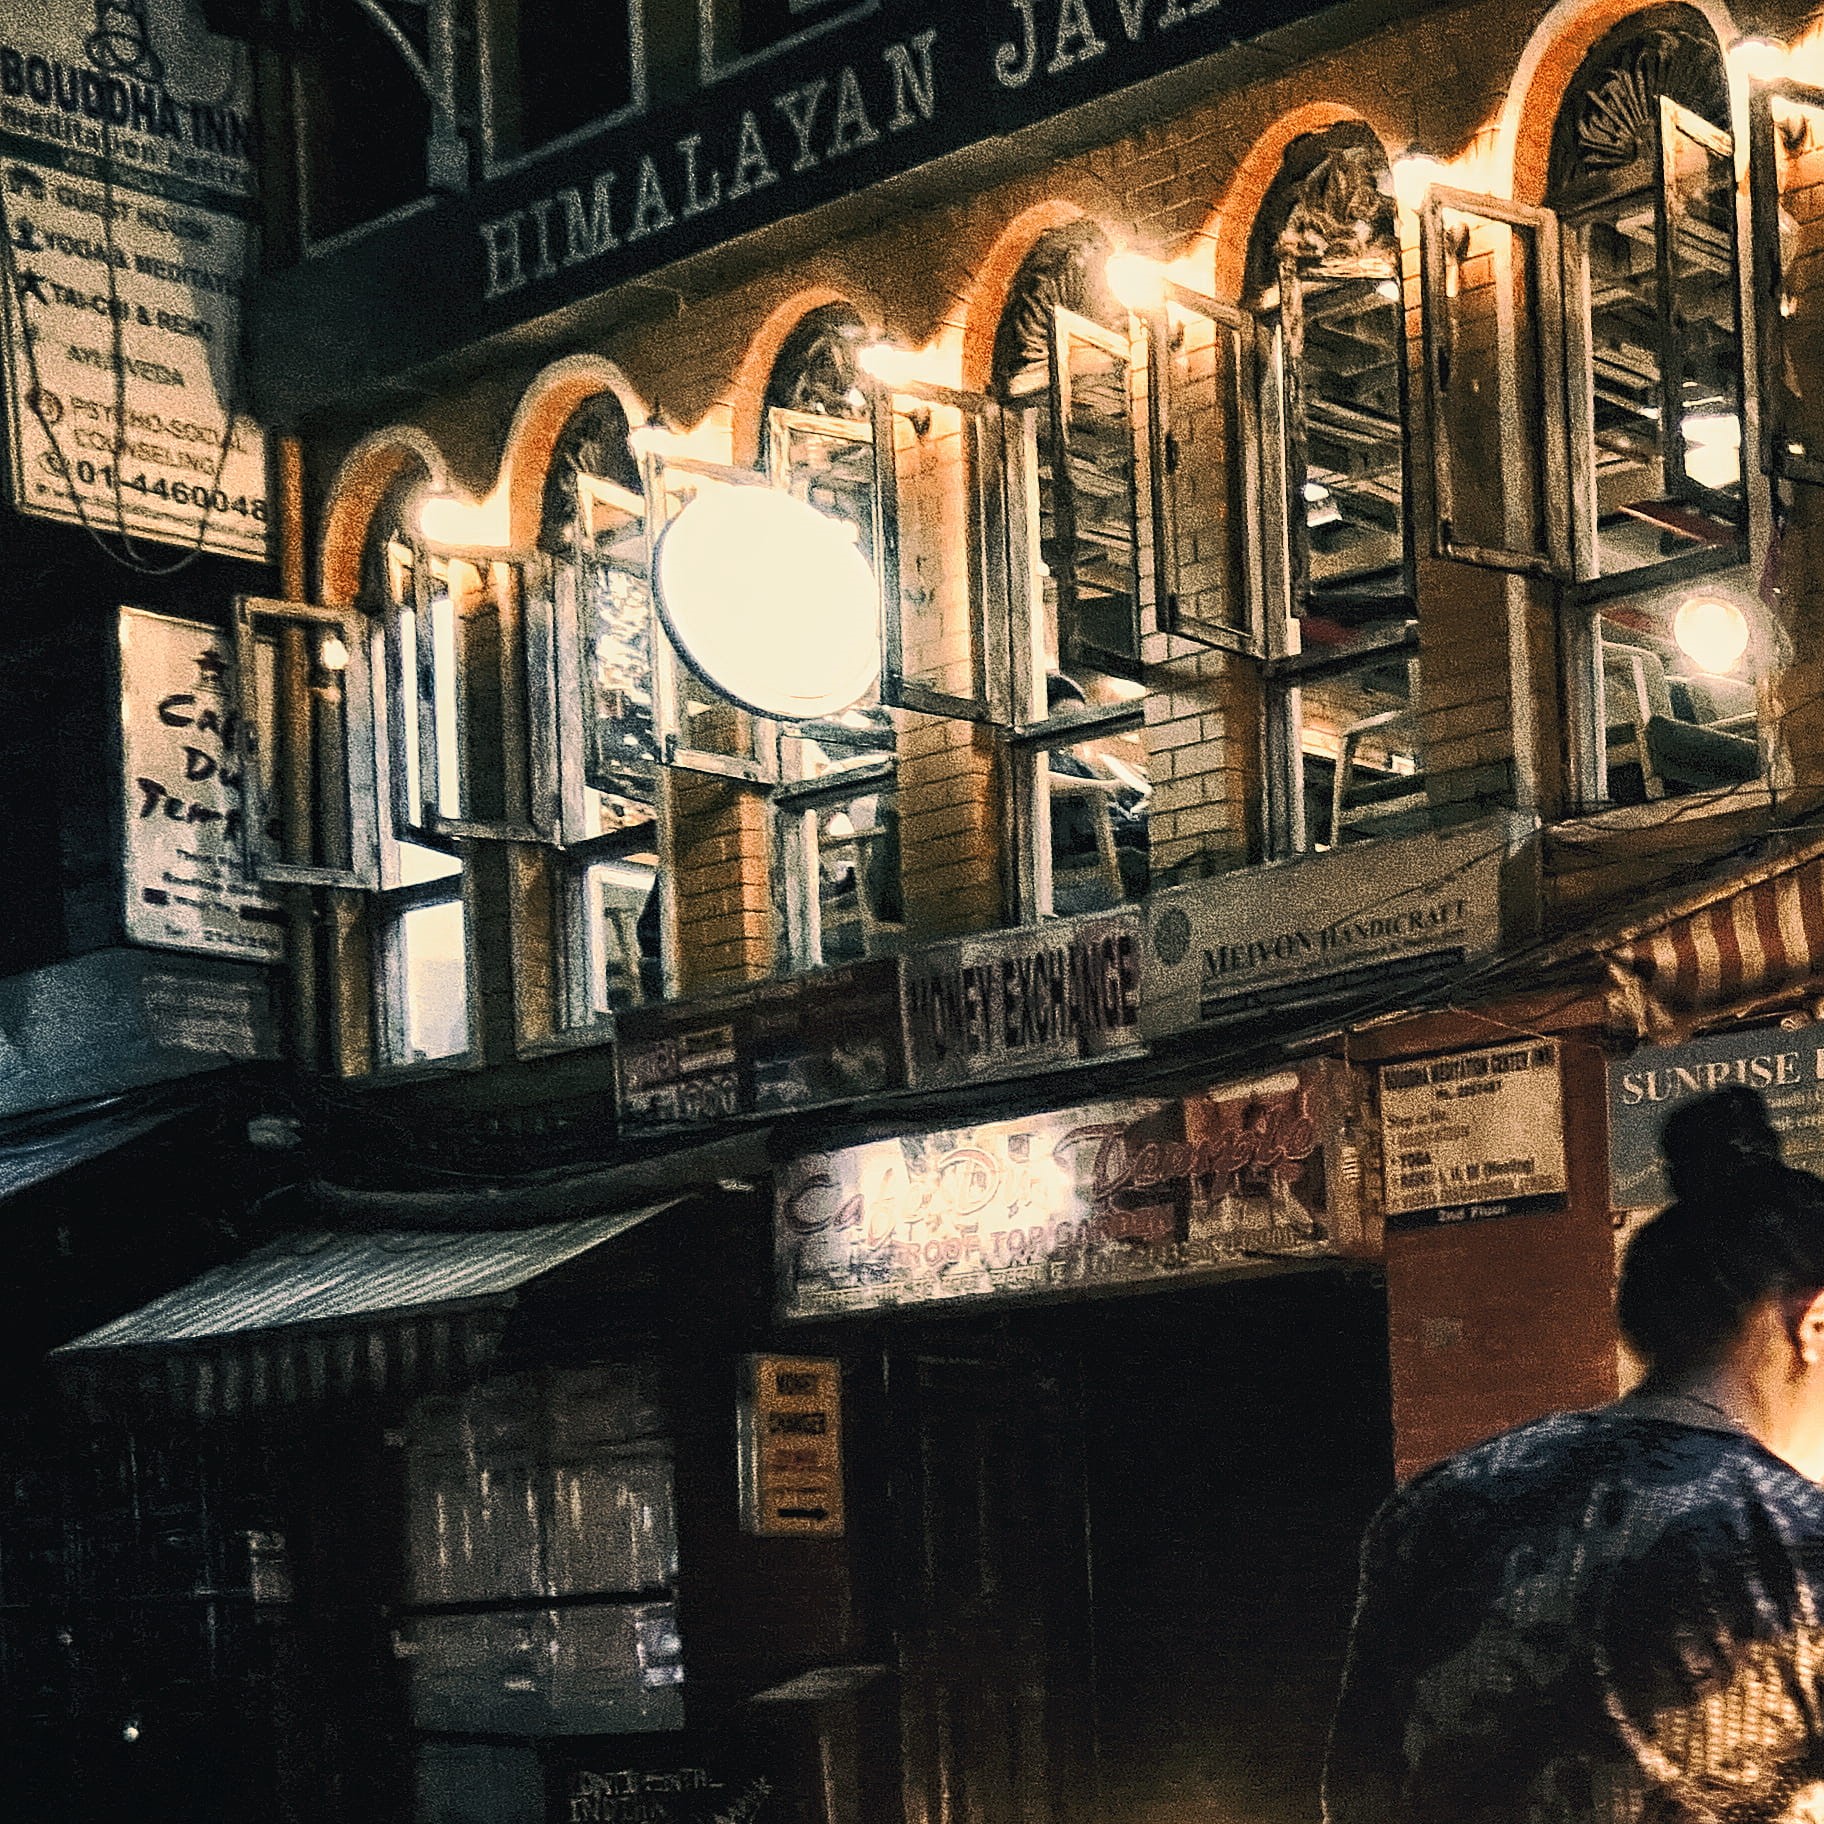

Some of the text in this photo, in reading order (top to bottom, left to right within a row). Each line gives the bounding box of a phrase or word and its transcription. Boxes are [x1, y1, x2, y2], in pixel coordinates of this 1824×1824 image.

[0, 47, 182, 141] BOUDDHA
[479, 28, 938, 300] HIMALAYAN
[76, 459, 268, 522] 01-4460048
[1319, 899, 1467, 951] HANDICRAFT
[1003, 935, 1140, 1048] EXCHANGE
[1621, 1049, 1801, 1106] SUNRISE
